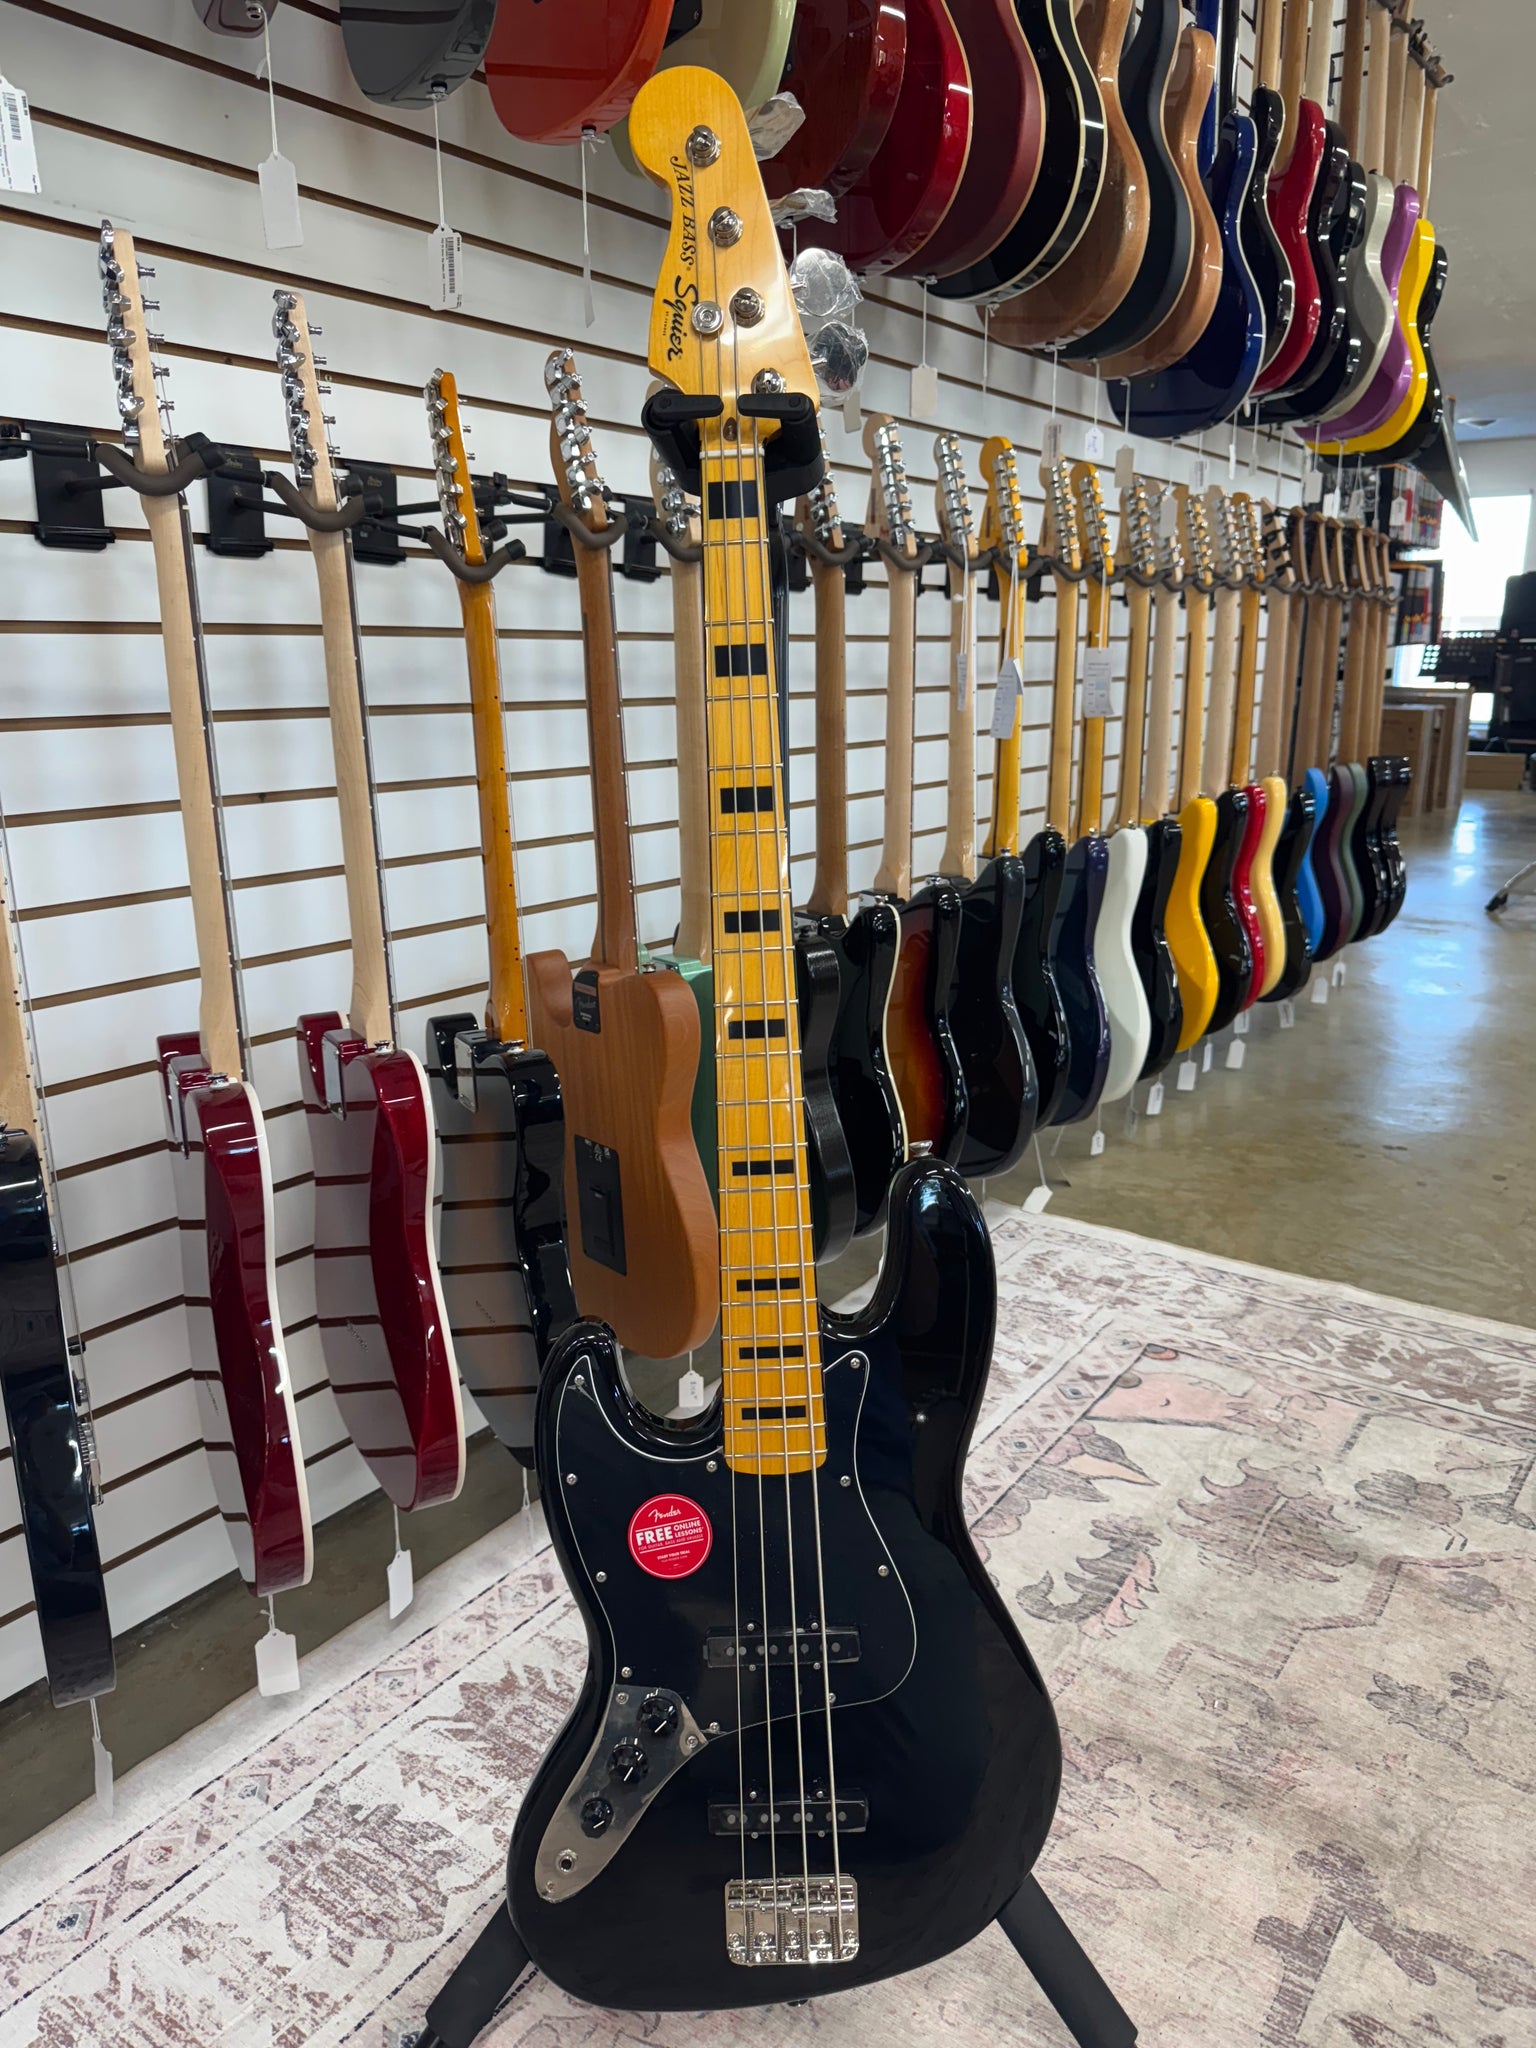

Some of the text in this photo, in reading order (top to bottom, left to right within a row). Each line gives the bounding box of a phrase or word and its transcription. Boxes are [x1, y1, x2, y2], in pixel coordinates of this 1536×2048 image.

[670, 156, 695, 207] JAZZ
[663, 275, 699, 363] Squier
[648, 1505, 680, 1522] Fender
[673, 1520, 701, 1531] ONLINE
[635, 1526, 673, 1546] FREE
